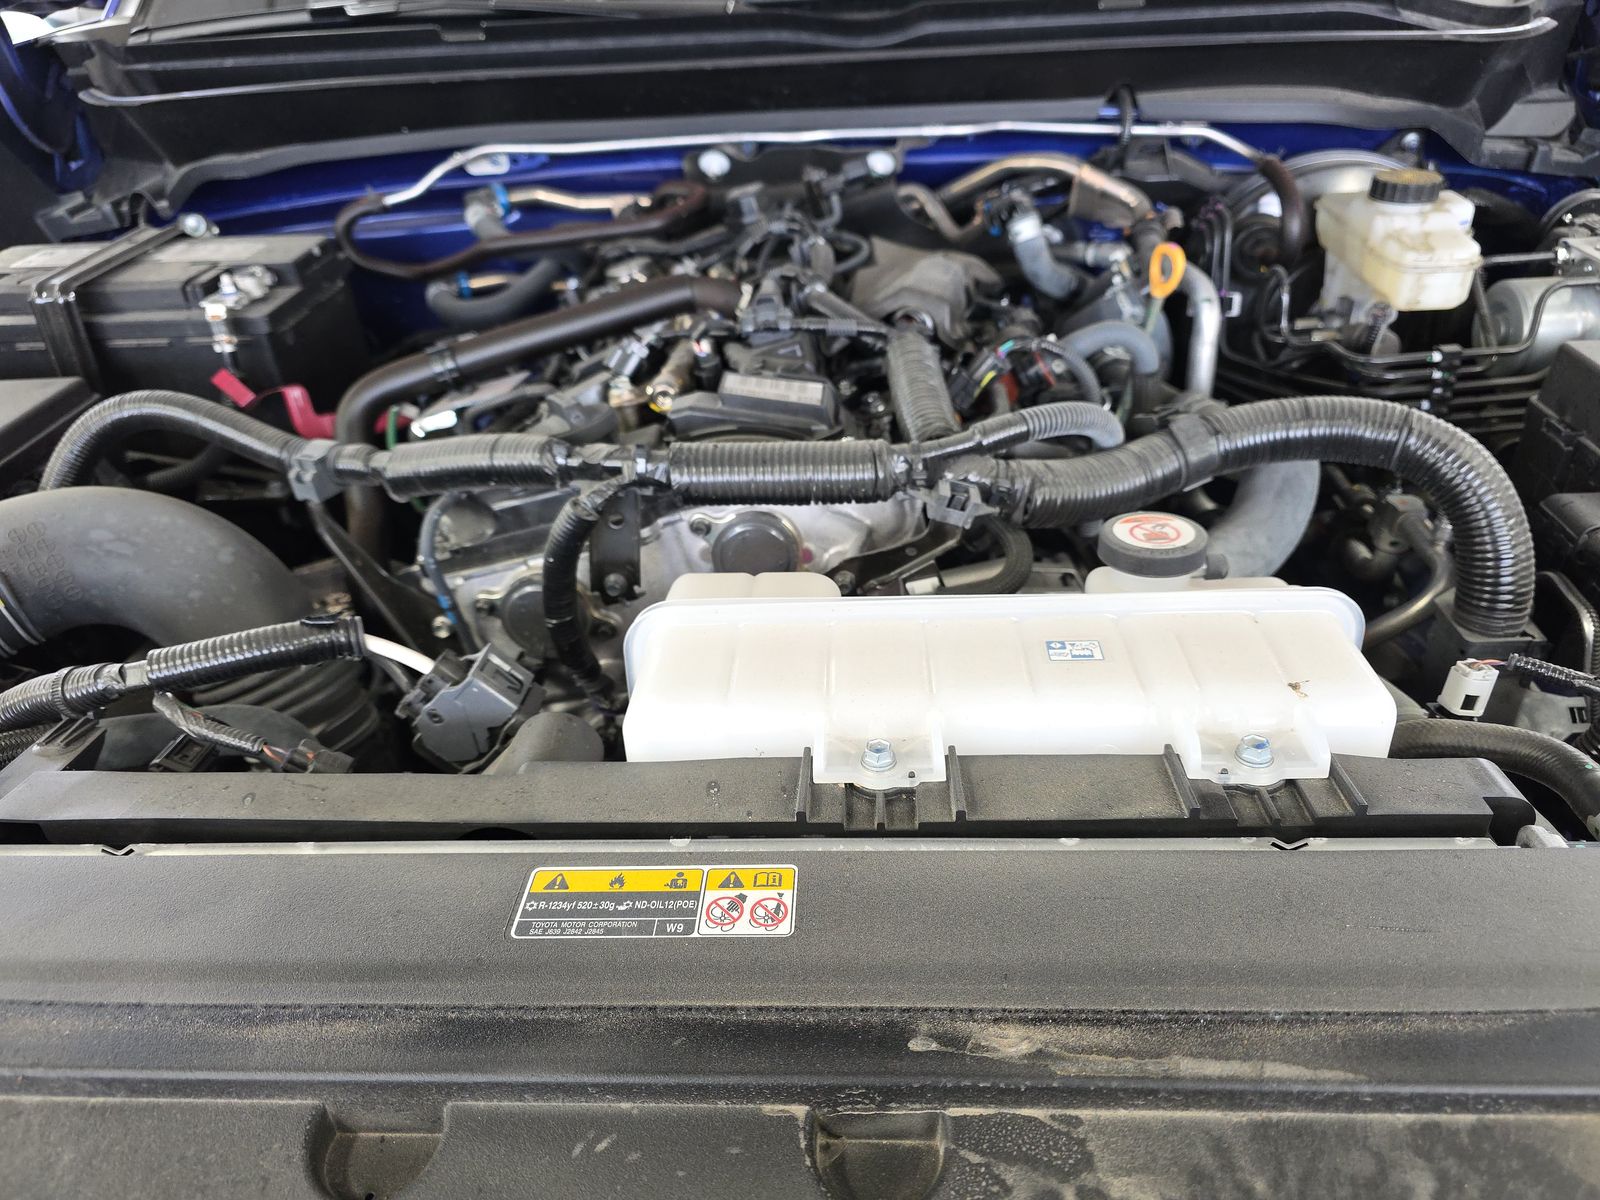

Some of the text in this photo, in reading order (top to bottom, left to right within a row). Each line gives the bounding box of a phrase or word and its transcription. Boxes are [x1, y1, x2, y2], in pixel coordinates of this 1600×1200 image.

[538, 900, 576, 911] R-1234yf
[634, 900, 698, 910] ND-OIL12(POE)
[666, 923, 684, 933] W9
